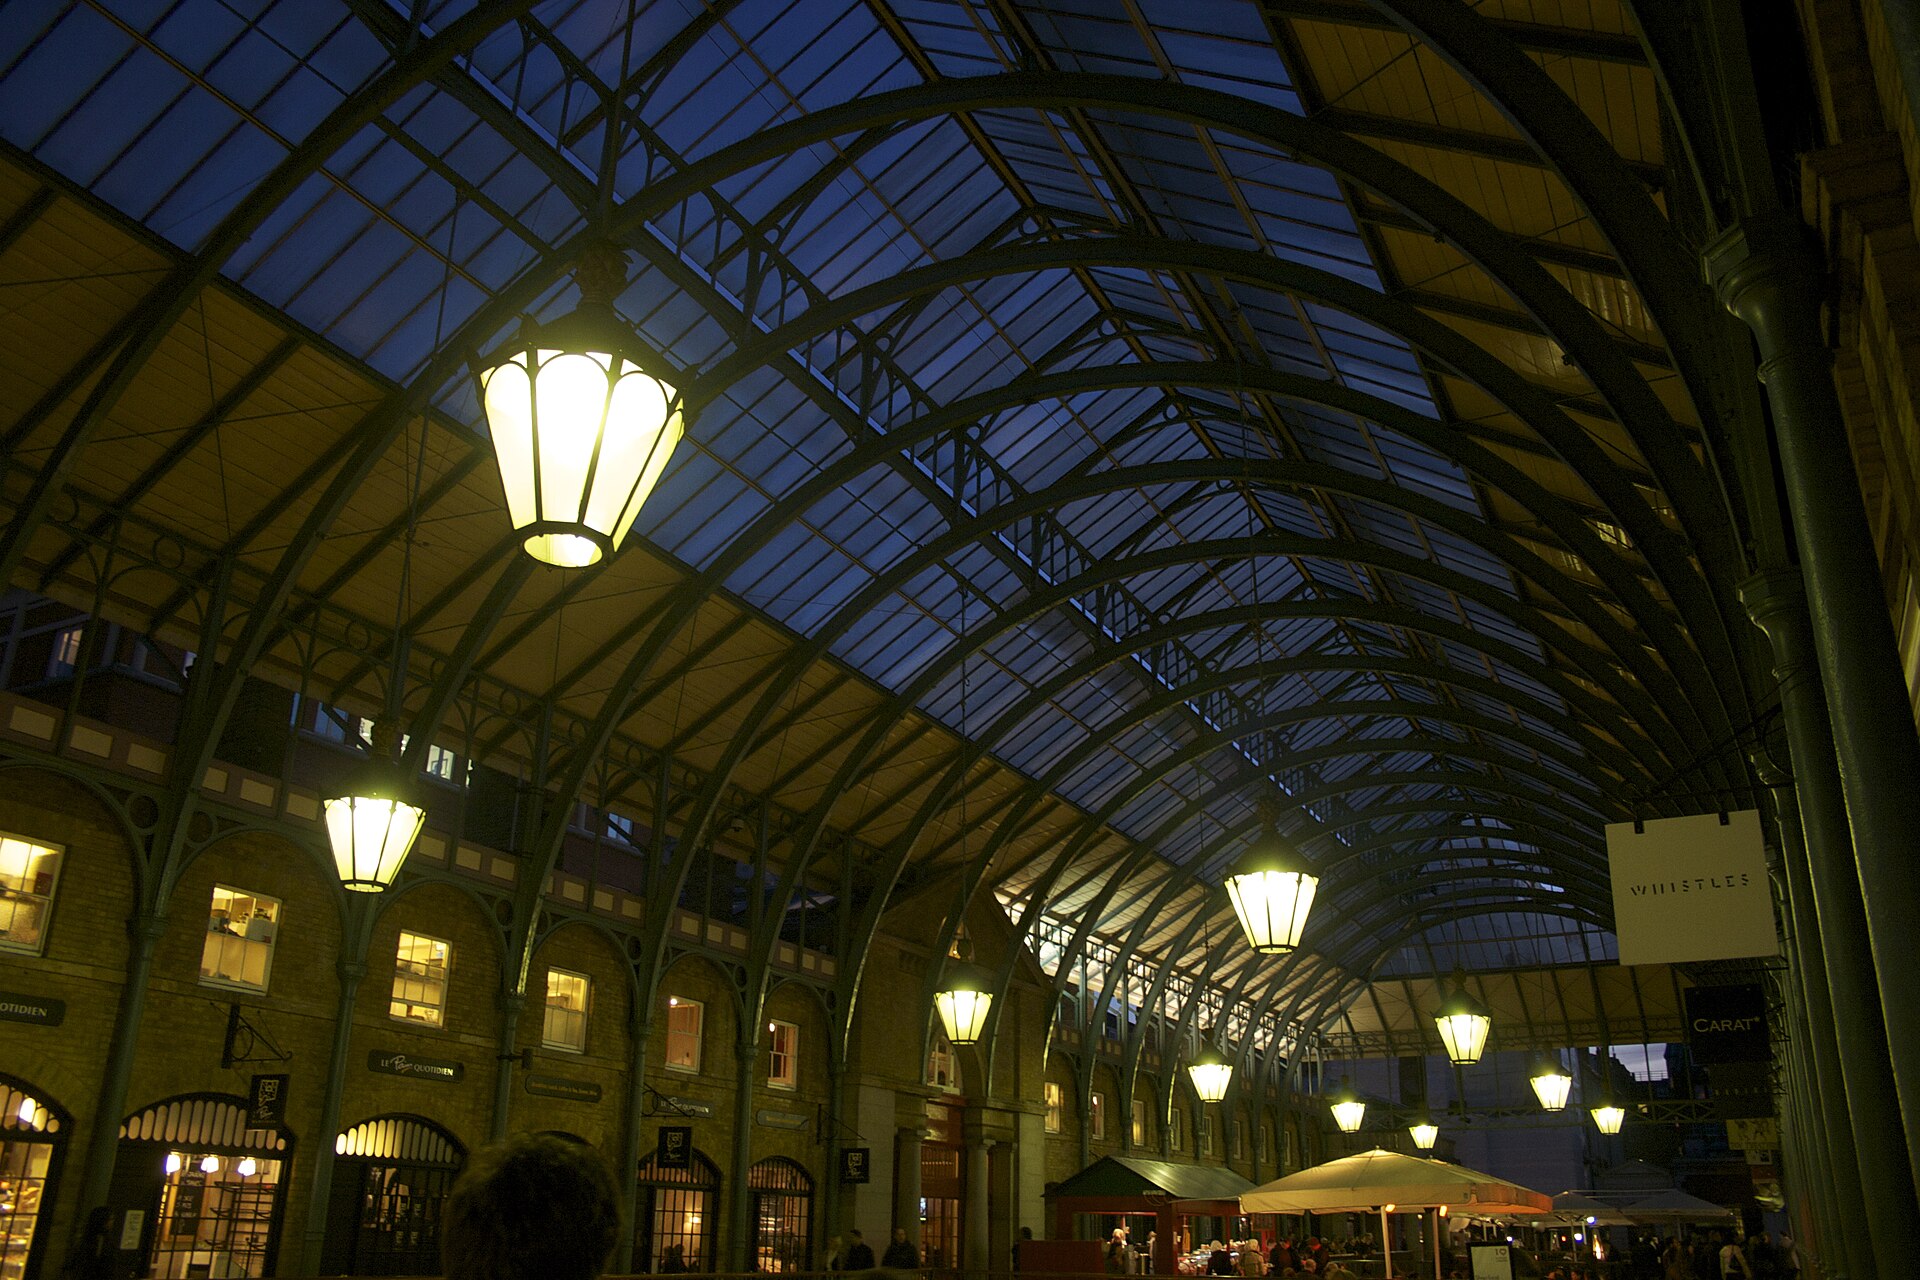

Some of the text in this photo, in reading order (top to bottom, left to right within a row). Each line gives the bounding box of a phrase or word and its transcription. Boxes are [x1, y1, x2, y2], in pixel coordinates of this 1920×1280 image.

[1631, 874, 1749, 896] WHISTLES
[381, 1059, 390, 1068] LE
[413, 1064, 454, 1077] QUOTIDIEN
